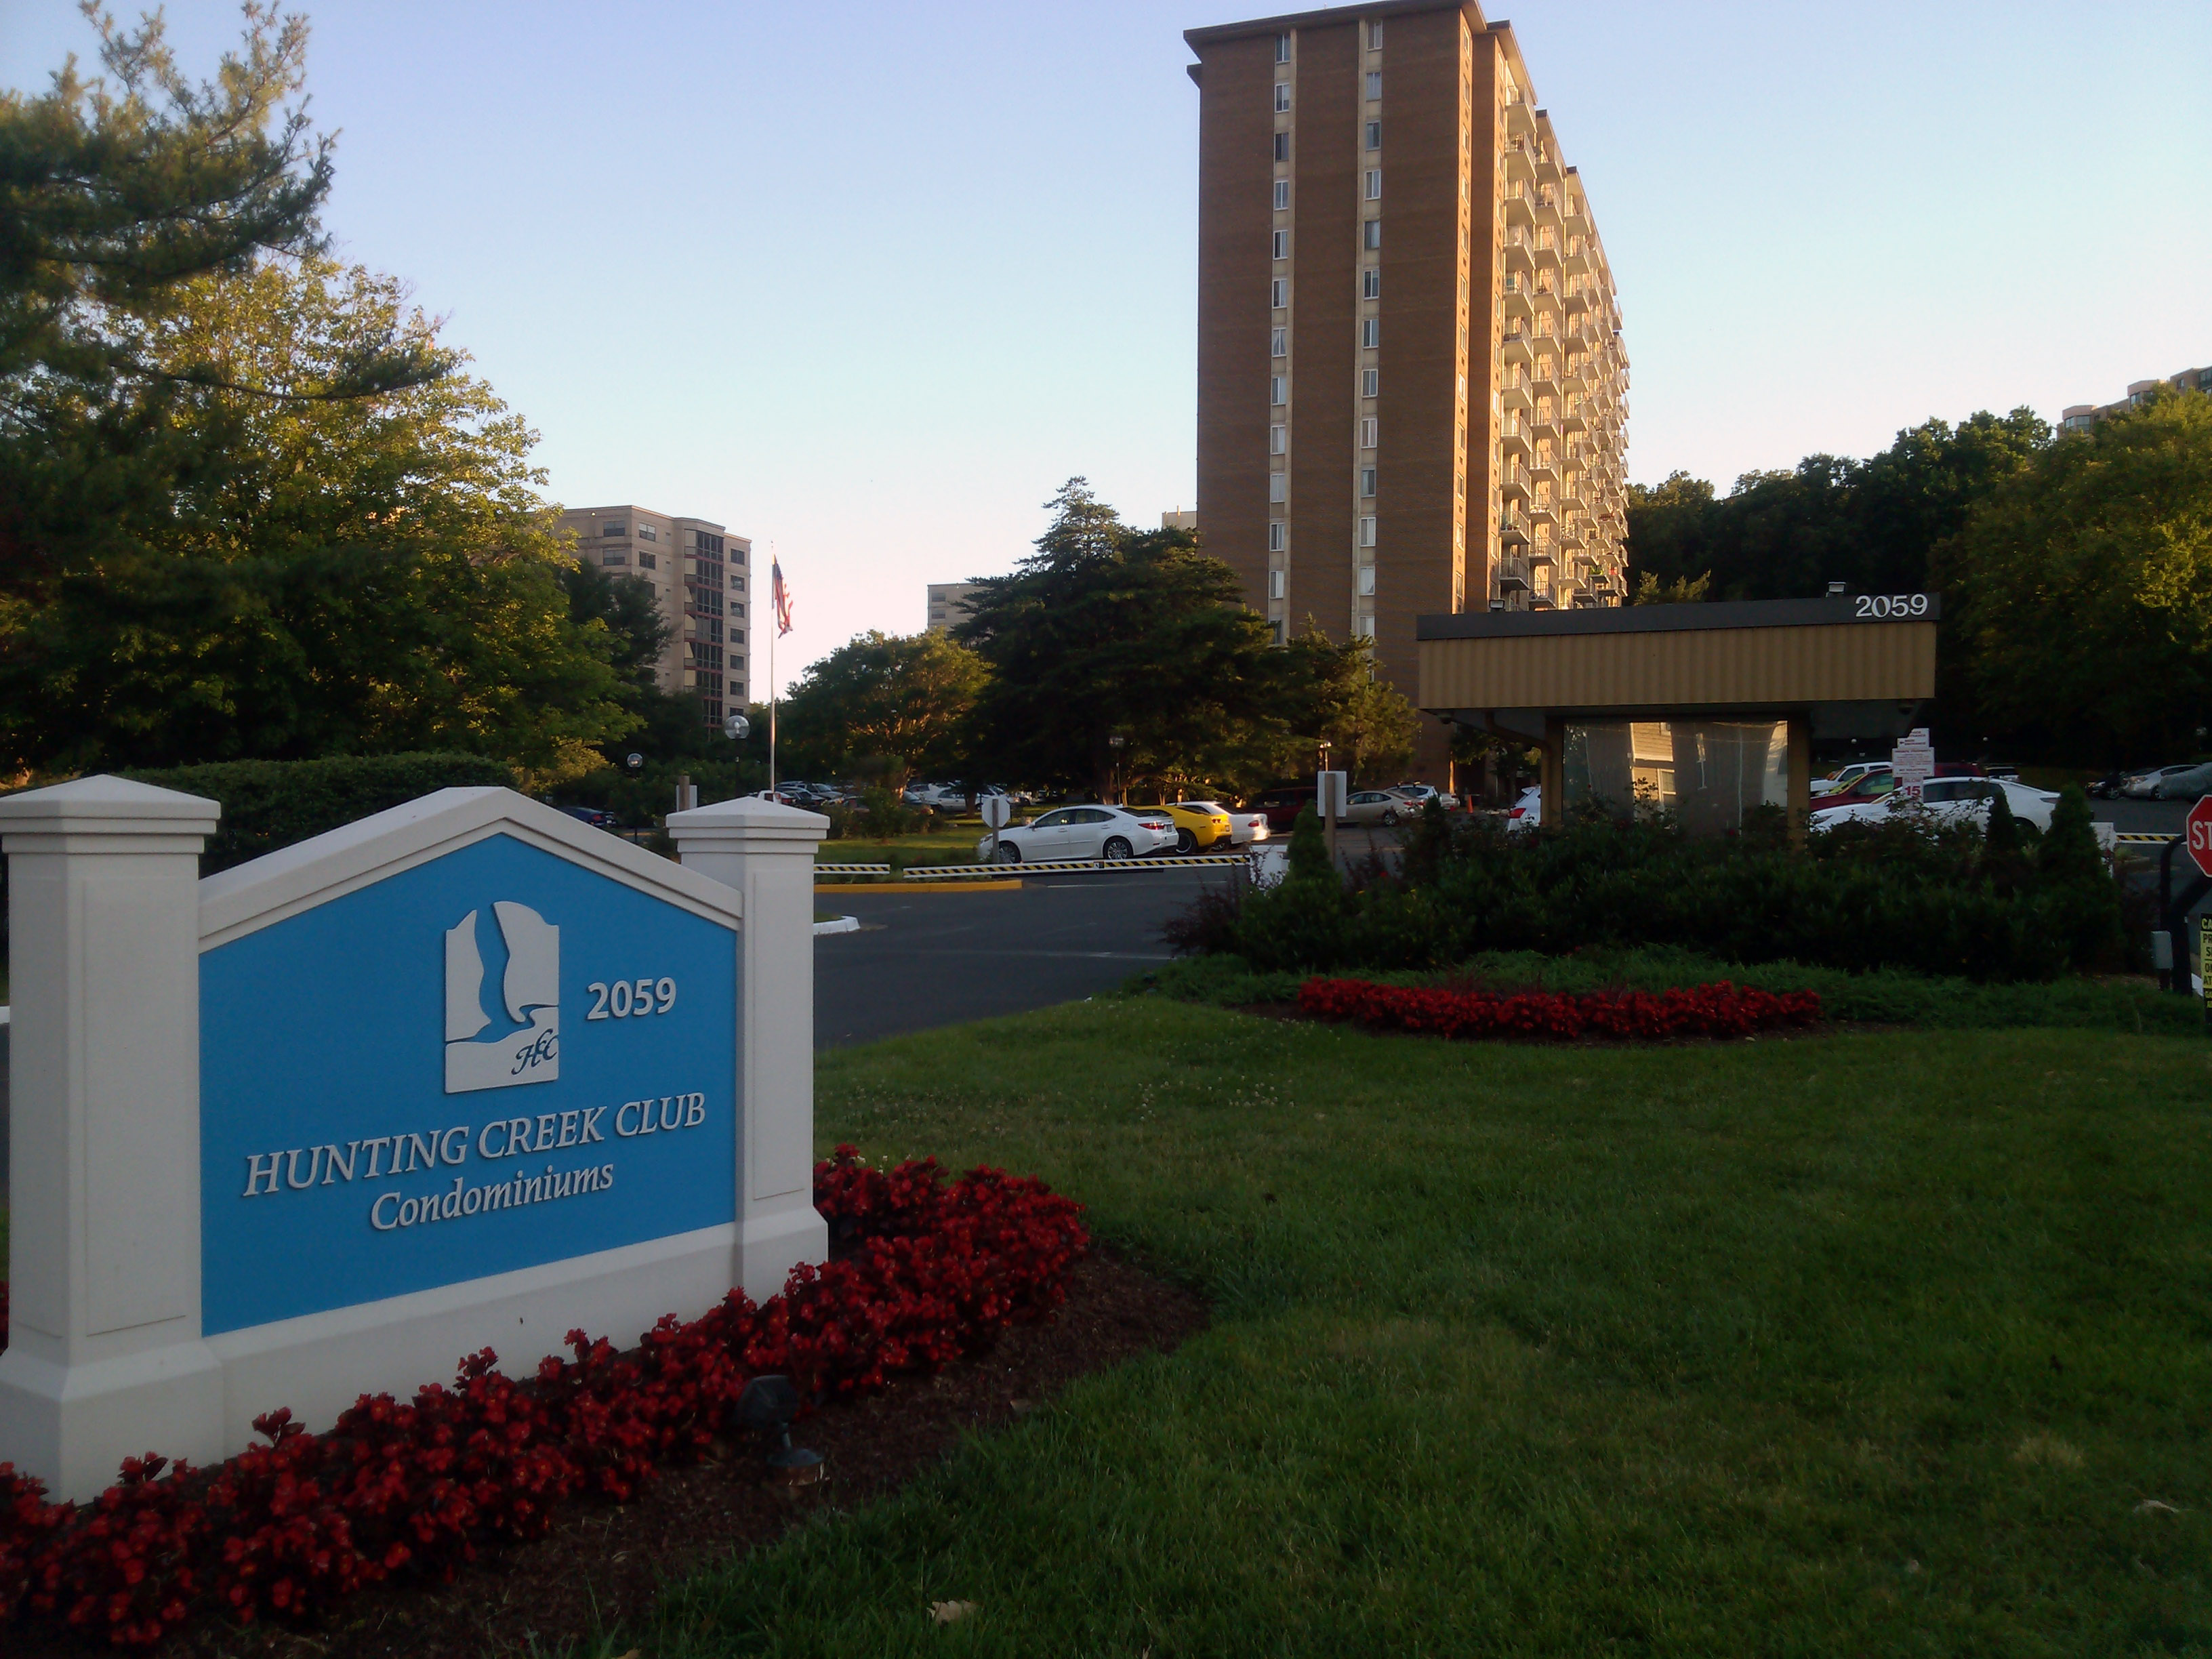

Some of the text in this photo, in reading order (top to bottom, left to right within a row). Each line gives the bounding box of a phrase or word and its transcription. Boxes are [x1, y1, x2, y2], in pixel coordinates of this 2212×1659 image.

[1855, 594, 1928, 617] 2059
[1904, 785, 1921, 796] 15
[587, 977, 676, 1021] 2059
[242, 1092, 706, 1197] HUNTING CREEK CLUB
[371, 1164, 614, 1230] Condominiums
